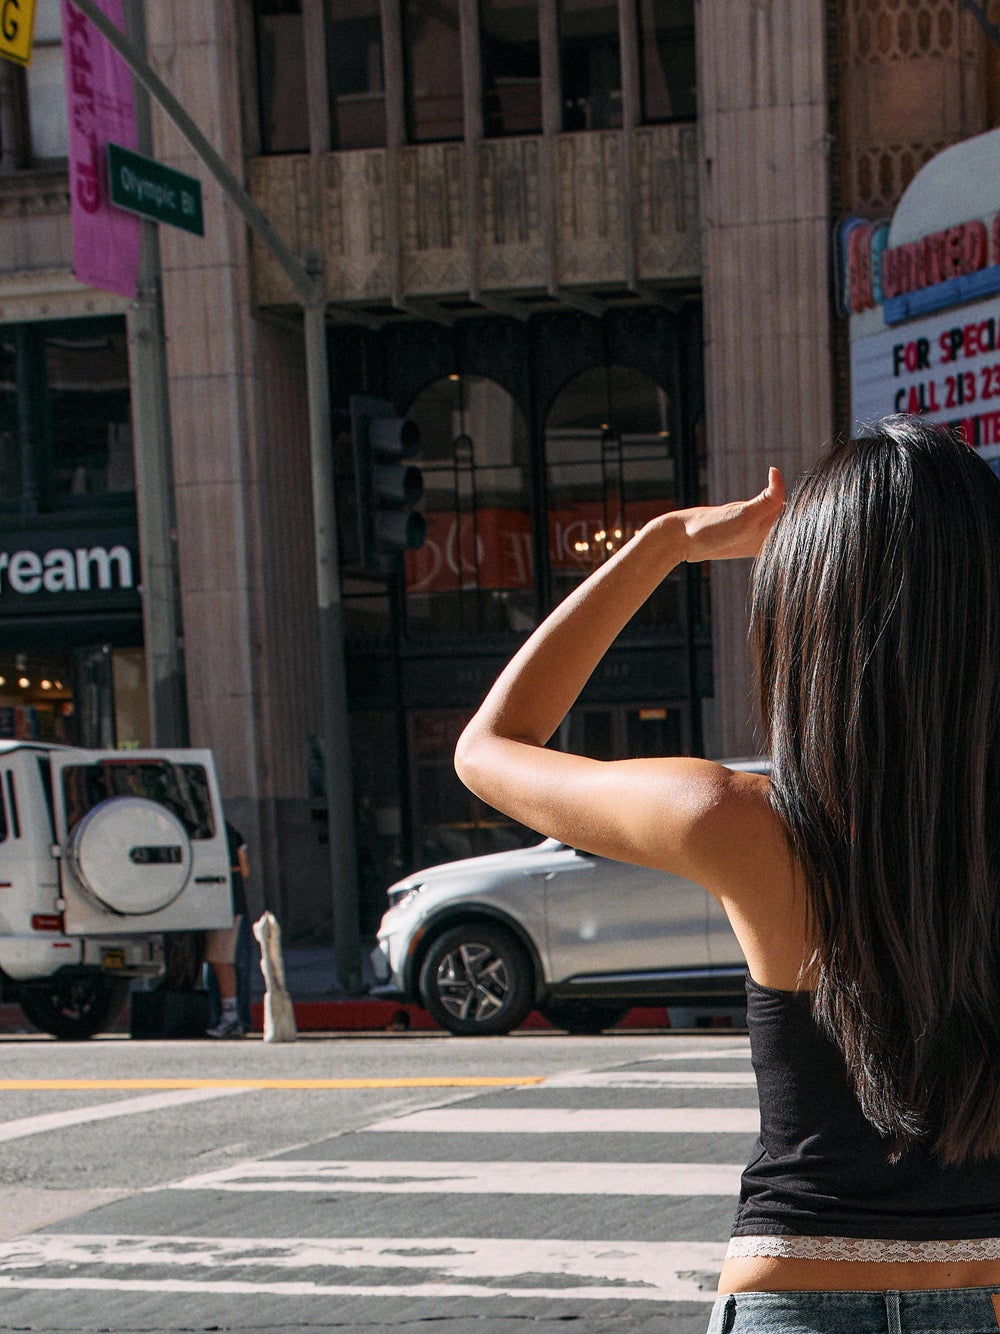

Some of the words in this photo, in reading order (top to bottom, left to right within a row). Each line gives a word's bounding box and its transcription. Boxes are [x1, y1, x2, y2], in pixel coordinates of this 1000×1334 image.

[882, 219, 988, 299] UNITED
[892, 337, 931, 377] FOR
[895, 380, 941, 415] CALL
[944, 370, 978, 410] 213
